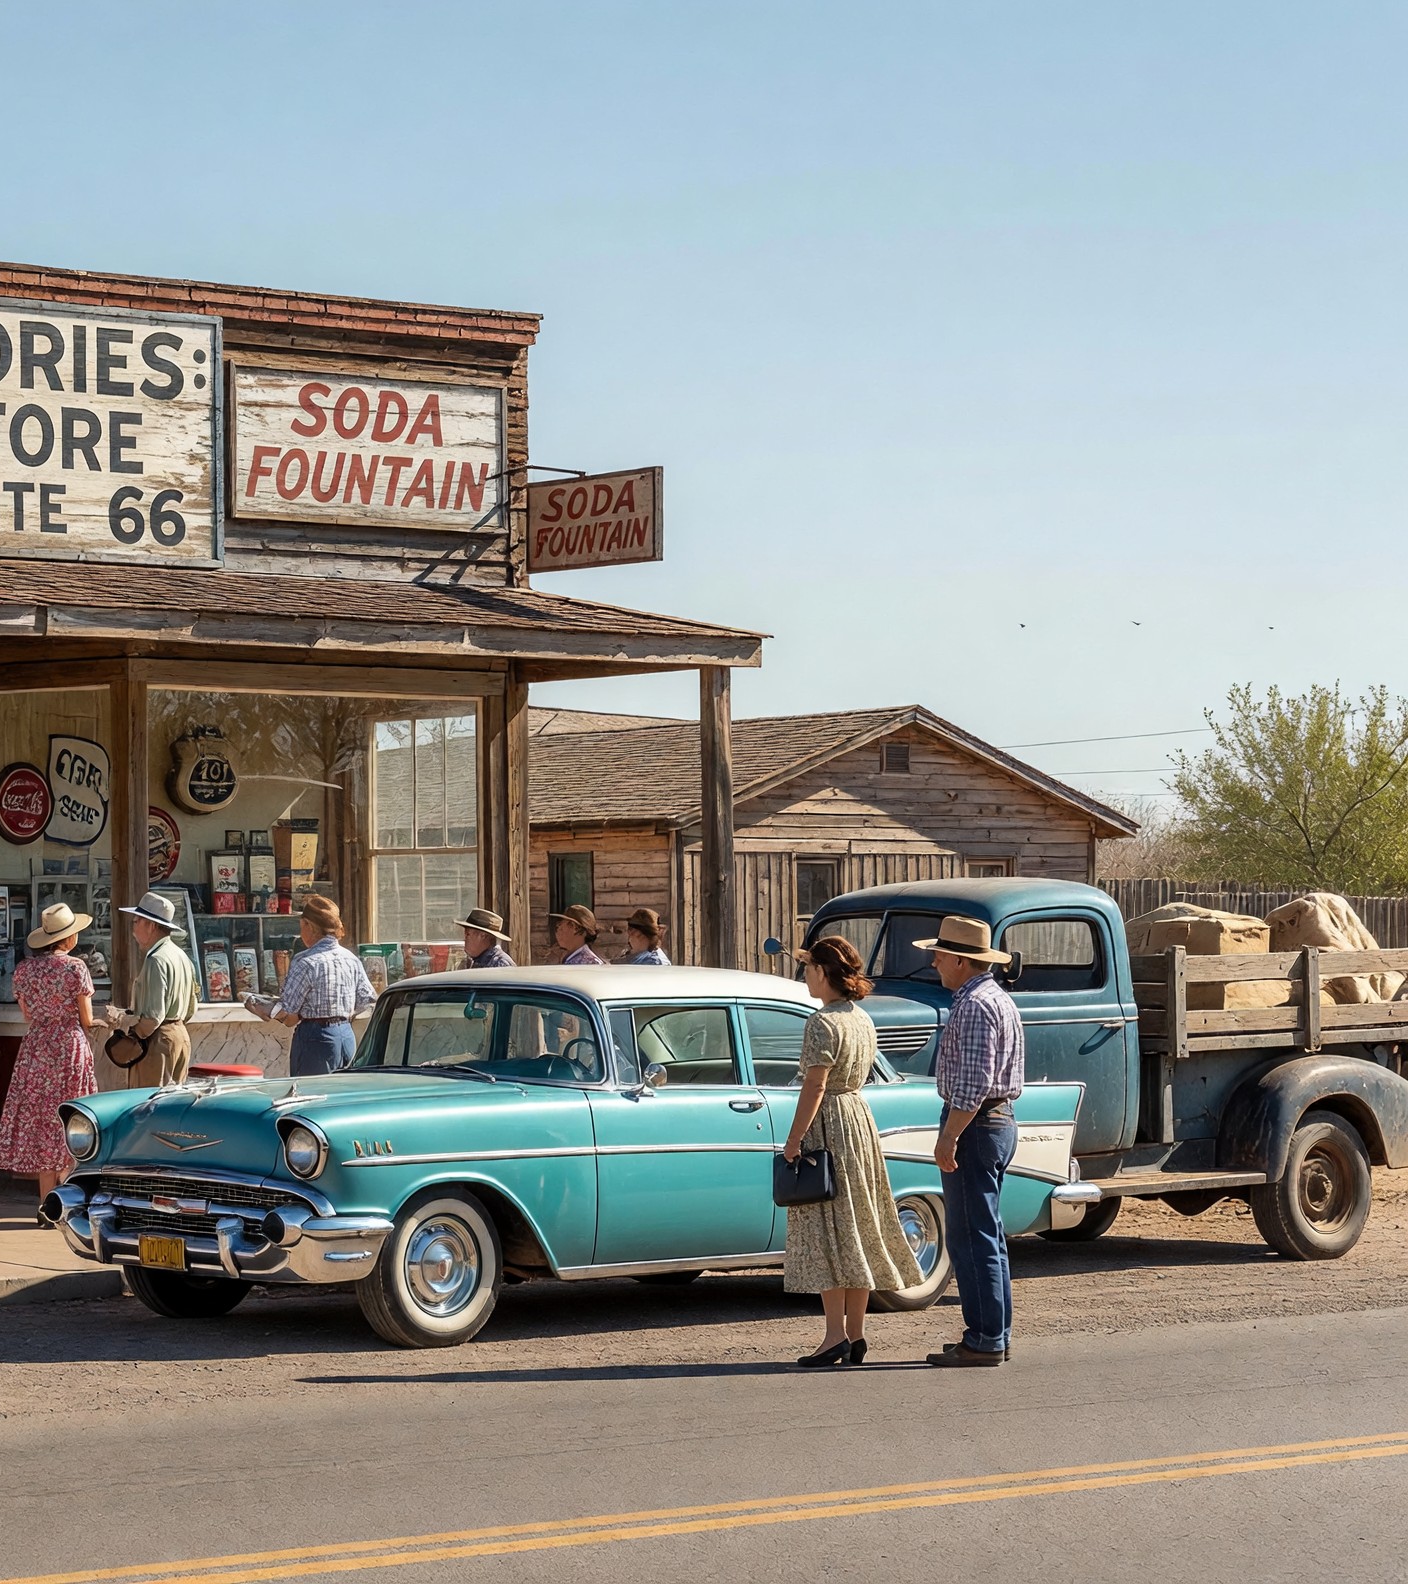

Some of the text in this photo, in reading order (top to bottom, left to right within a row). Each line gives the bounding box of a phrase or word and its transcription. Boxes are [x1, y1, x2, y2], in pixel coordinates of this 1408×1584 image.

[290, 382, 443, 446] SODA
[245, 445, 490, 512] FOUNTAIN
[541, 481, 635, 522] SODA
[108, 485, 186, 547] 66
[535, 517, 648, 559] FOUNTAIN
